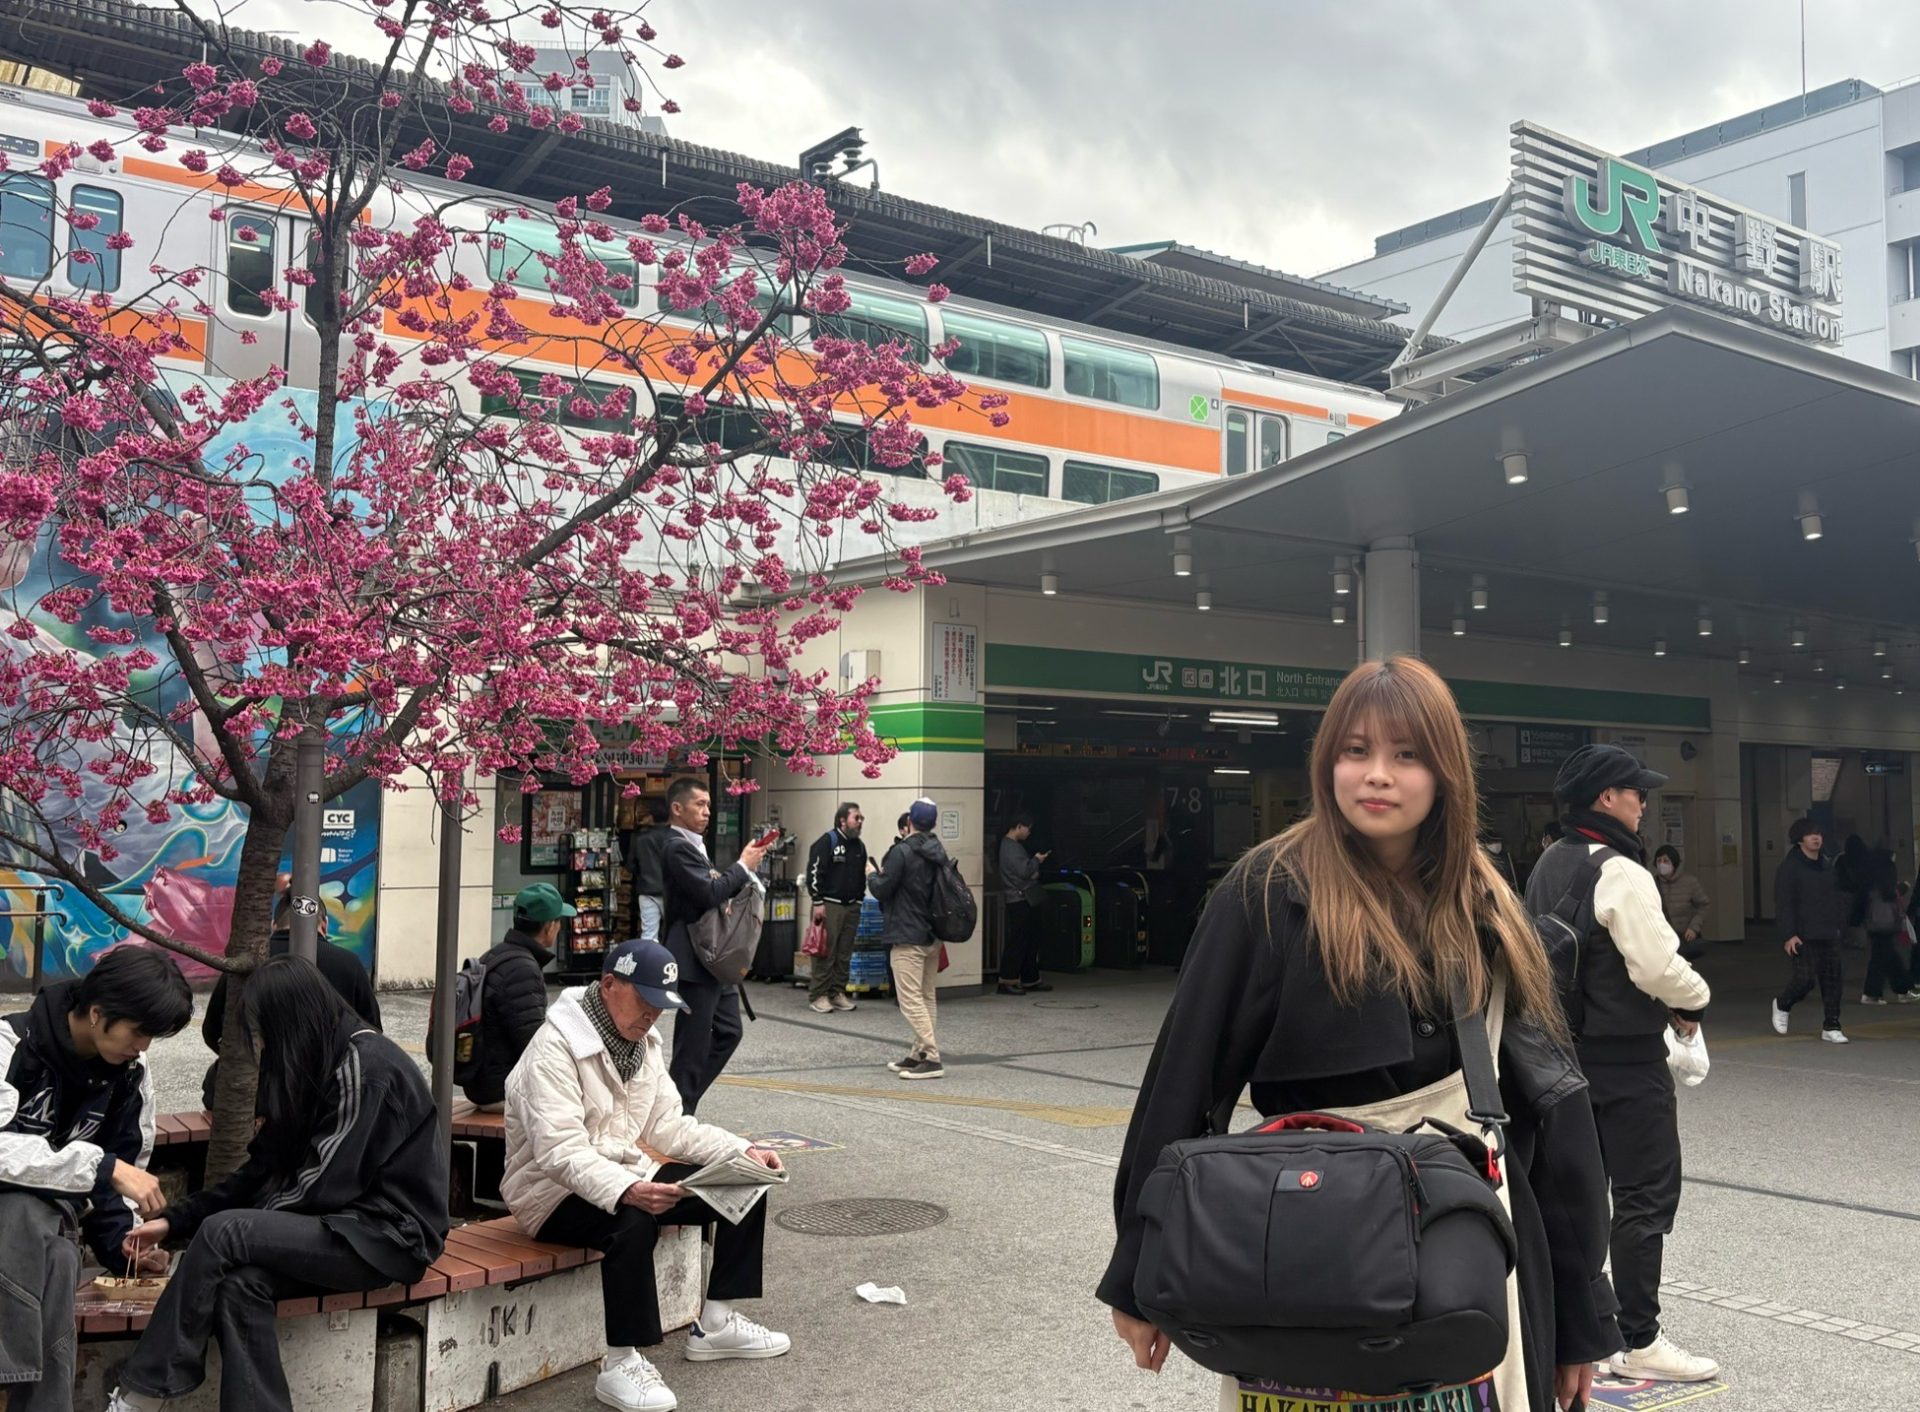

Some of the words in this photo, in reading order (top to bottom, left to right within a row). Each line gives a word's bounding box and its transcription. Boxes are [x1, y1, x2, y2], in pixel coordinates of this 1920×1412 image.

[1571, 157, 1662, 253] JR
[1589, 241, 1651, 279] JR東日本
[1675, 189, 1842, 303] 中野駅
[1677, 262, 1761, 316] Nakano
[1768, 292, 1841, 342] Station
[1142, 660, 1173, 683] JR
[1219, 665, 1266, 696] 北口
[1276, 671, 1303, 685] North
[1305, 673, 1344, 687] Entranc
[327, 813, 350, 823] CYC
